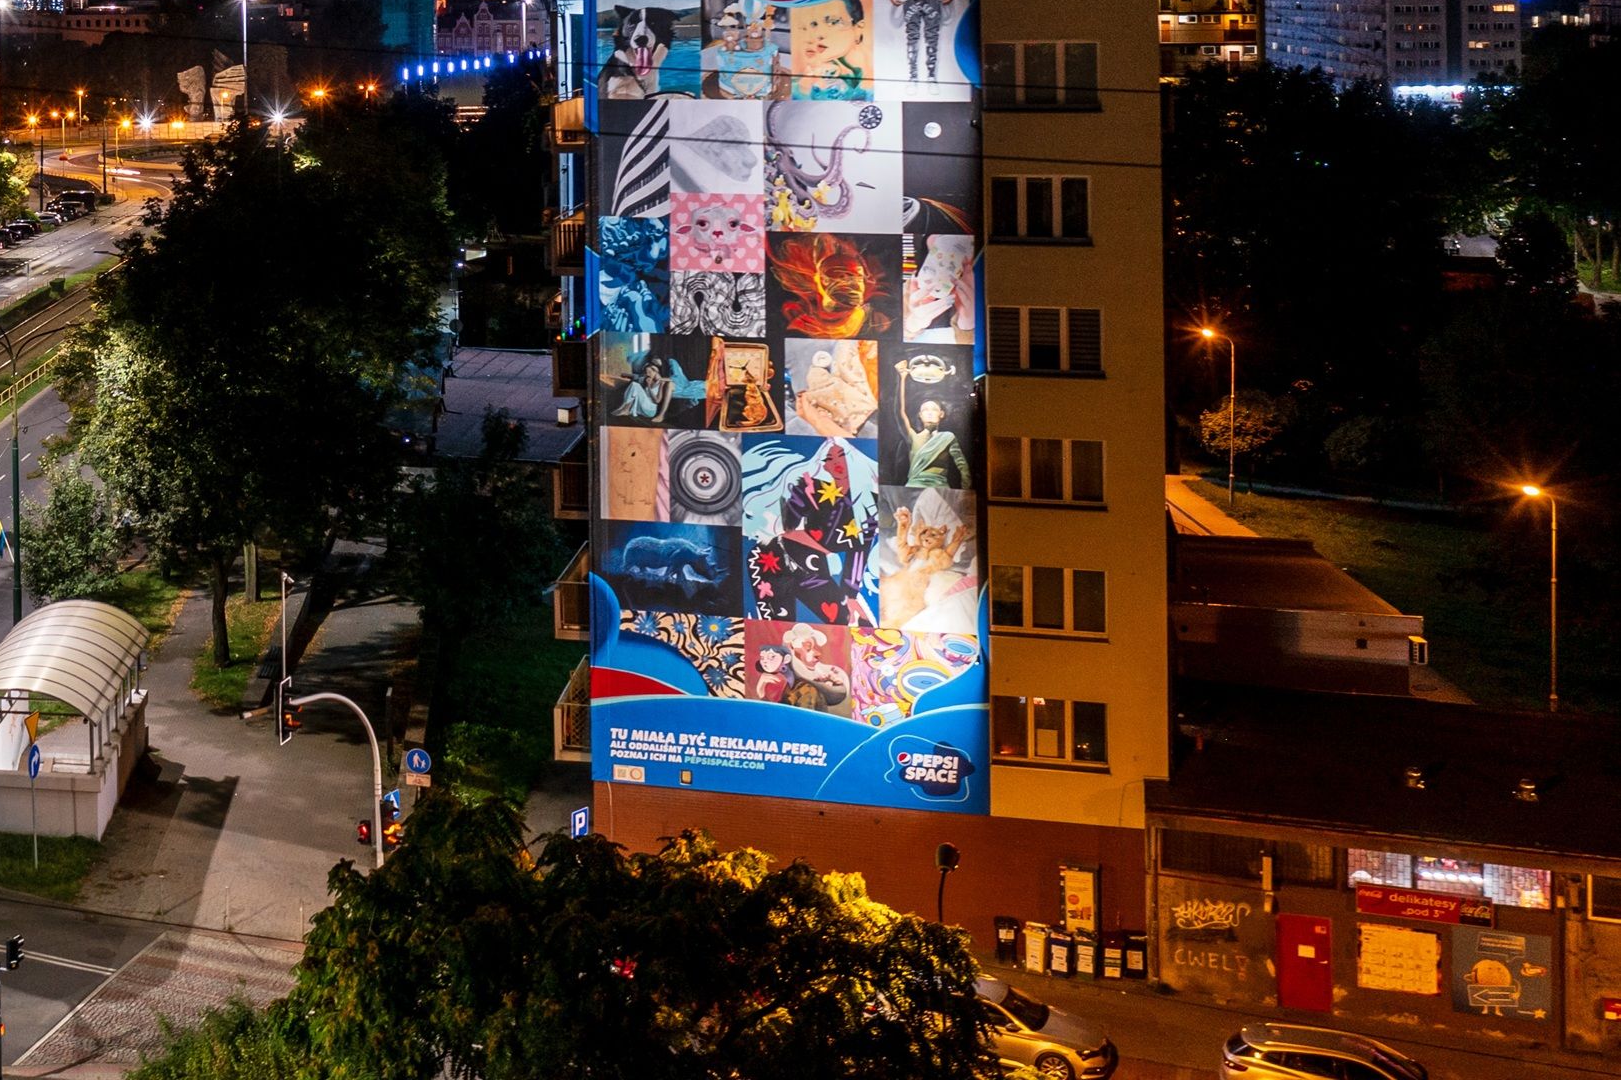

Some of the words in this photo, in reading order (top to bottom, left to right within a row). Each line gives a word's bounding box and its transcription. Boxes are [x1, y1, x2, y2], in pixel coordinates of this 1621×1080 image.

[610, 728, 628, 740] TU
[631, 730, 676, 744] MIAŁA
[679, 732, 707, 747] BYĆ
[709, 735, 779, 753] REKLAMA
[782, 742, 827, 761] PEPSI,
[610, 740, 627, 749] ALE
[628, 742, 683, 754] ODDALIŚMY
[684, 746, 696, 756] JĄ
[697, 748, 763, 761] ZWYCIĘZCOM
[765, 753, 792, 763] PEPSI
[793, 756, 827, 766] SPACE.
[610, 749, 648, 760] POZNAJ
[650, 752, 666, 761] ICH
[668, 754, 682, 763] NA
[684, 756, 765, 770] PEPSISPACE.COM
[911, 753, 959, 769] PEPSI
[905, 766, 958, 783] SPACE
[575, 811, 586, 836] P
[1388, 892, 1457, 911] delikatesy
